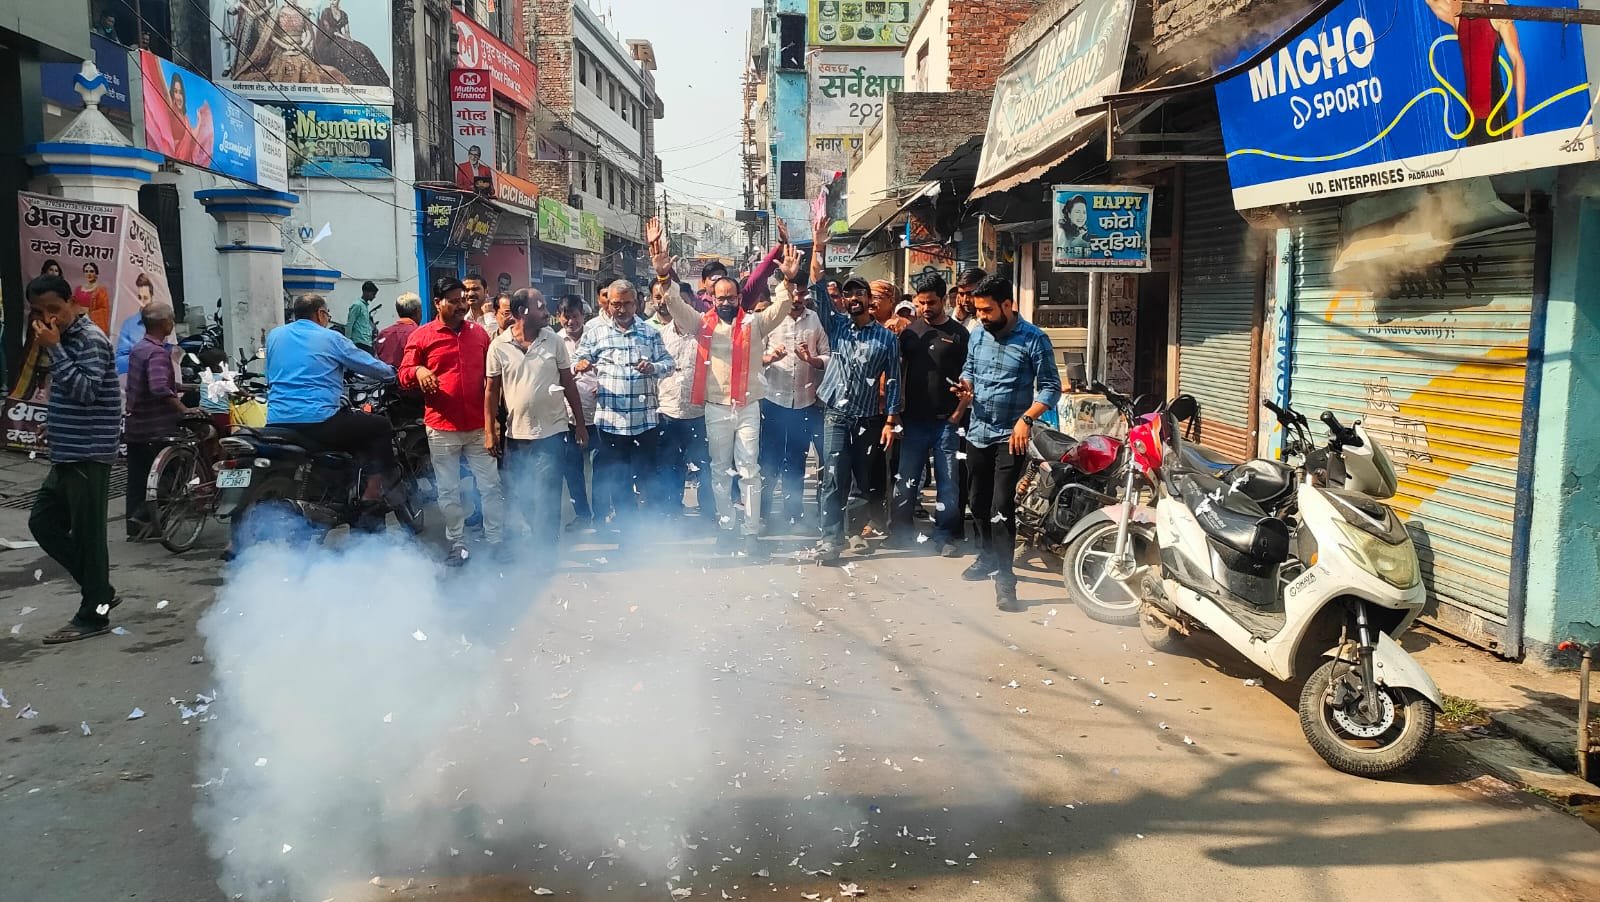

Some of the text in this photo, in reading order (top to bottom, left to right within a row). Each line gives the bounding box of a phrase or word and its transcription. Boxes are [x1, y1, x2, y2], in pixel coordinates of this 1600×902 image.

[1034, 10, 1088, 86] HAPPY
[1248, 17, 1375, 103] MACHO
[454, 85, 488, 94] Muthoot
[1313, 76, 1382, 119] SPORTO
[456, 107, 488, 121] गोल्ड
[1013, 86, 1048, 130] PHOTO
[296, 109, 389, 141] Moments
[458, 122, 487, 136] लोन
[315, 139, 371, 157] STUDIO
[815, 137, 844, 153] नगर
[1308, 168, 1445, 196] V.D. ENTERPRISES PADRAUNA
[499, 183, 537, 209] ICICI Bank
[1092, 195, 1143, 210] HAPPY
[24, 205, 118, 239] अनुराधा
[1098, 210, 1136, 230] फोटो
[30, 238, 115, 260] वस्त्र विभाग
[1090, 230, 1143, 257] स्टूडियो
